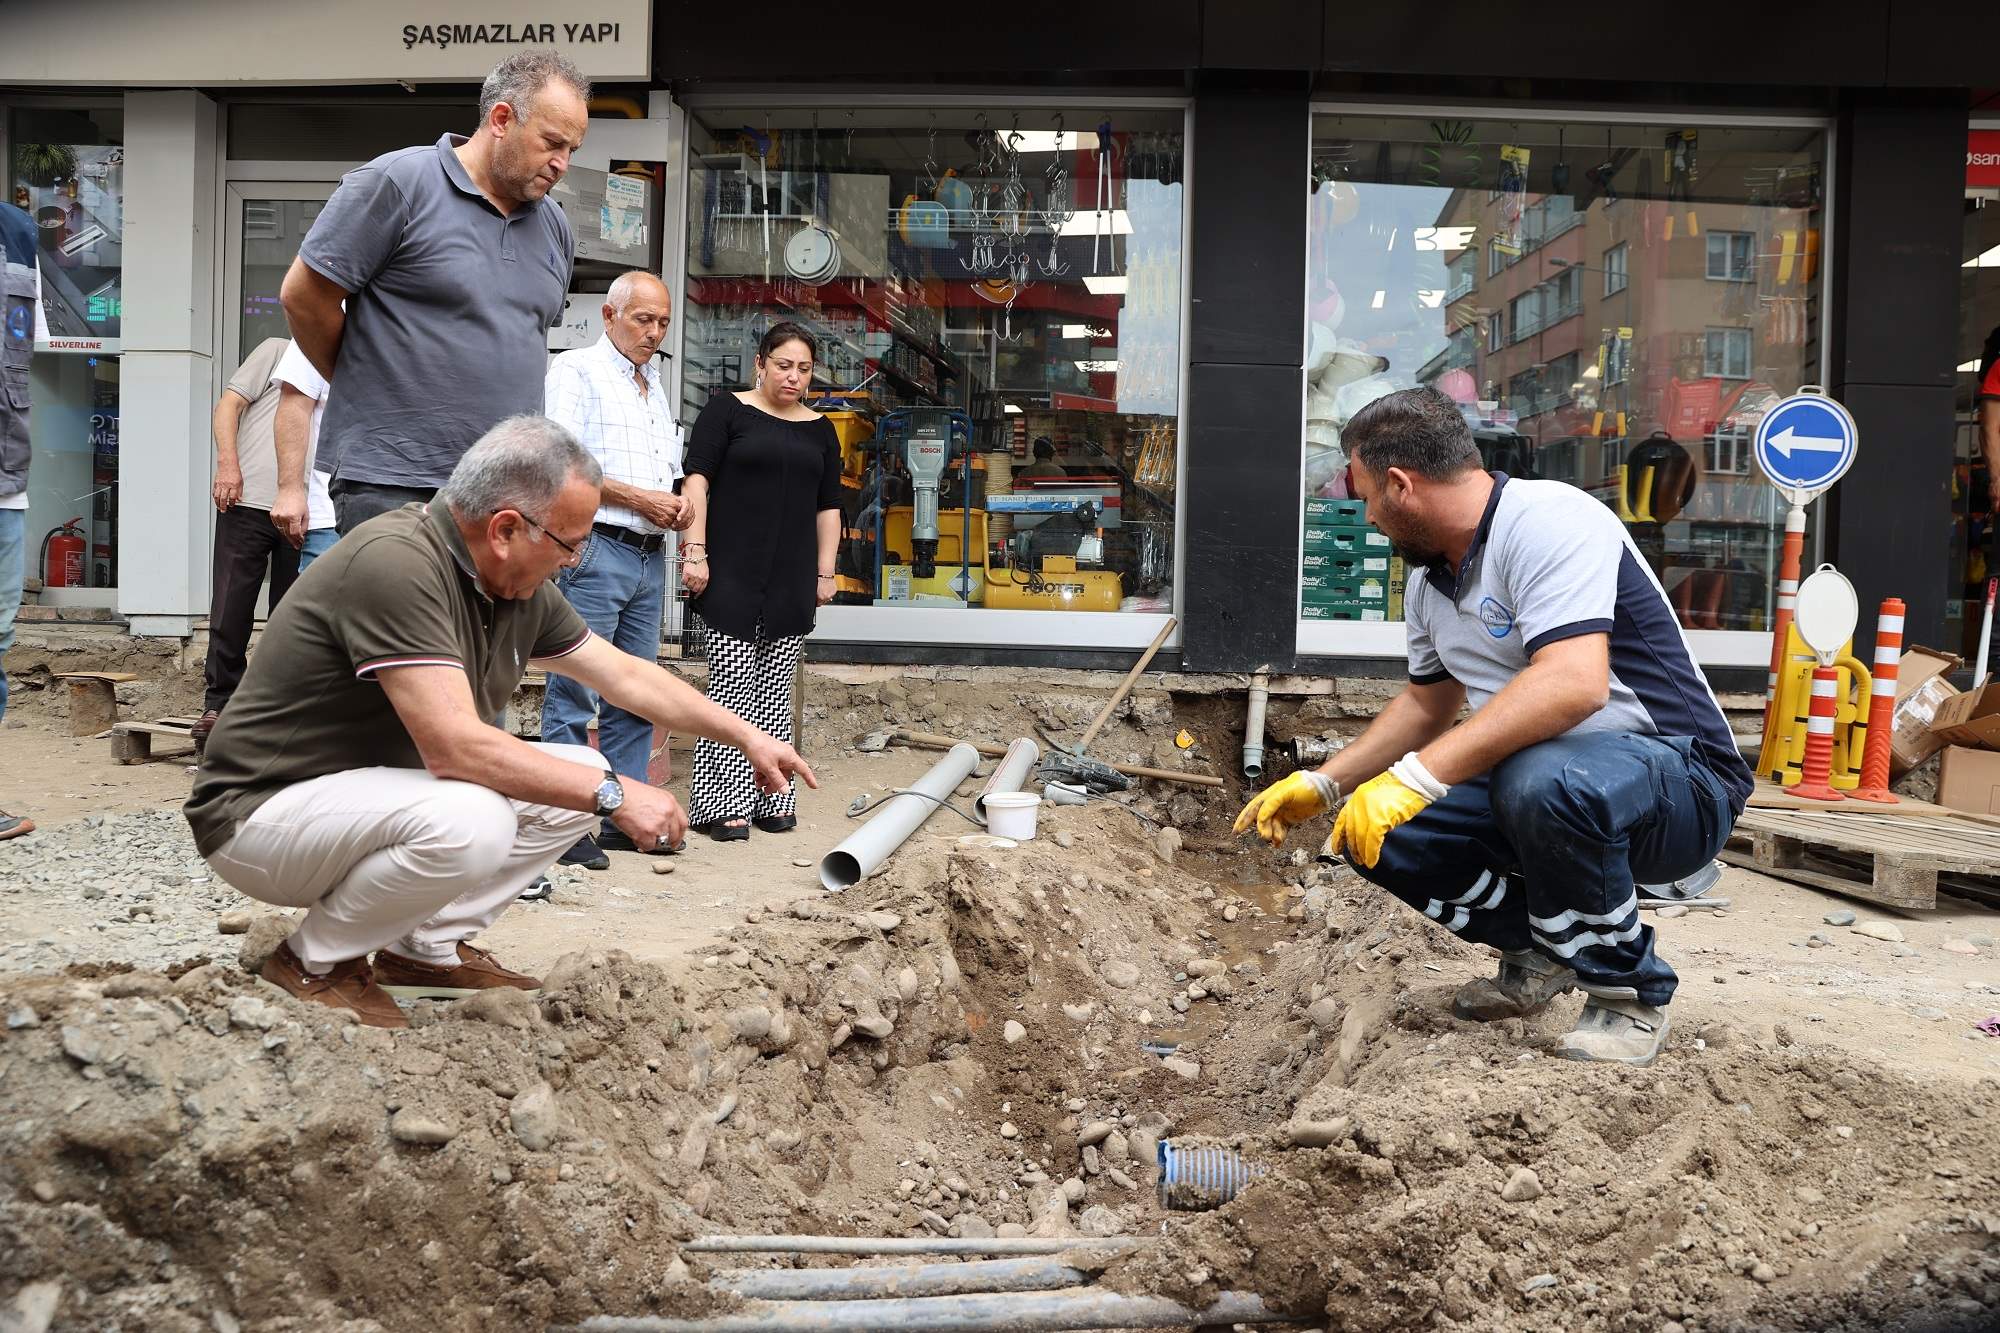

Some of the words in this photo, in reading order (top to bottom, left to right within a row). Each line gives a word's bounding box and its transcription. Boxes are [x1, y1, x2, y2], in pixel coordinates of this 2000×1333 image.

[402, 24, 555, 49] ŞAŞMAZLAR
[563, 23, 620, 43] YAPI
[49, 341, 102, 349] SILVERLINE
